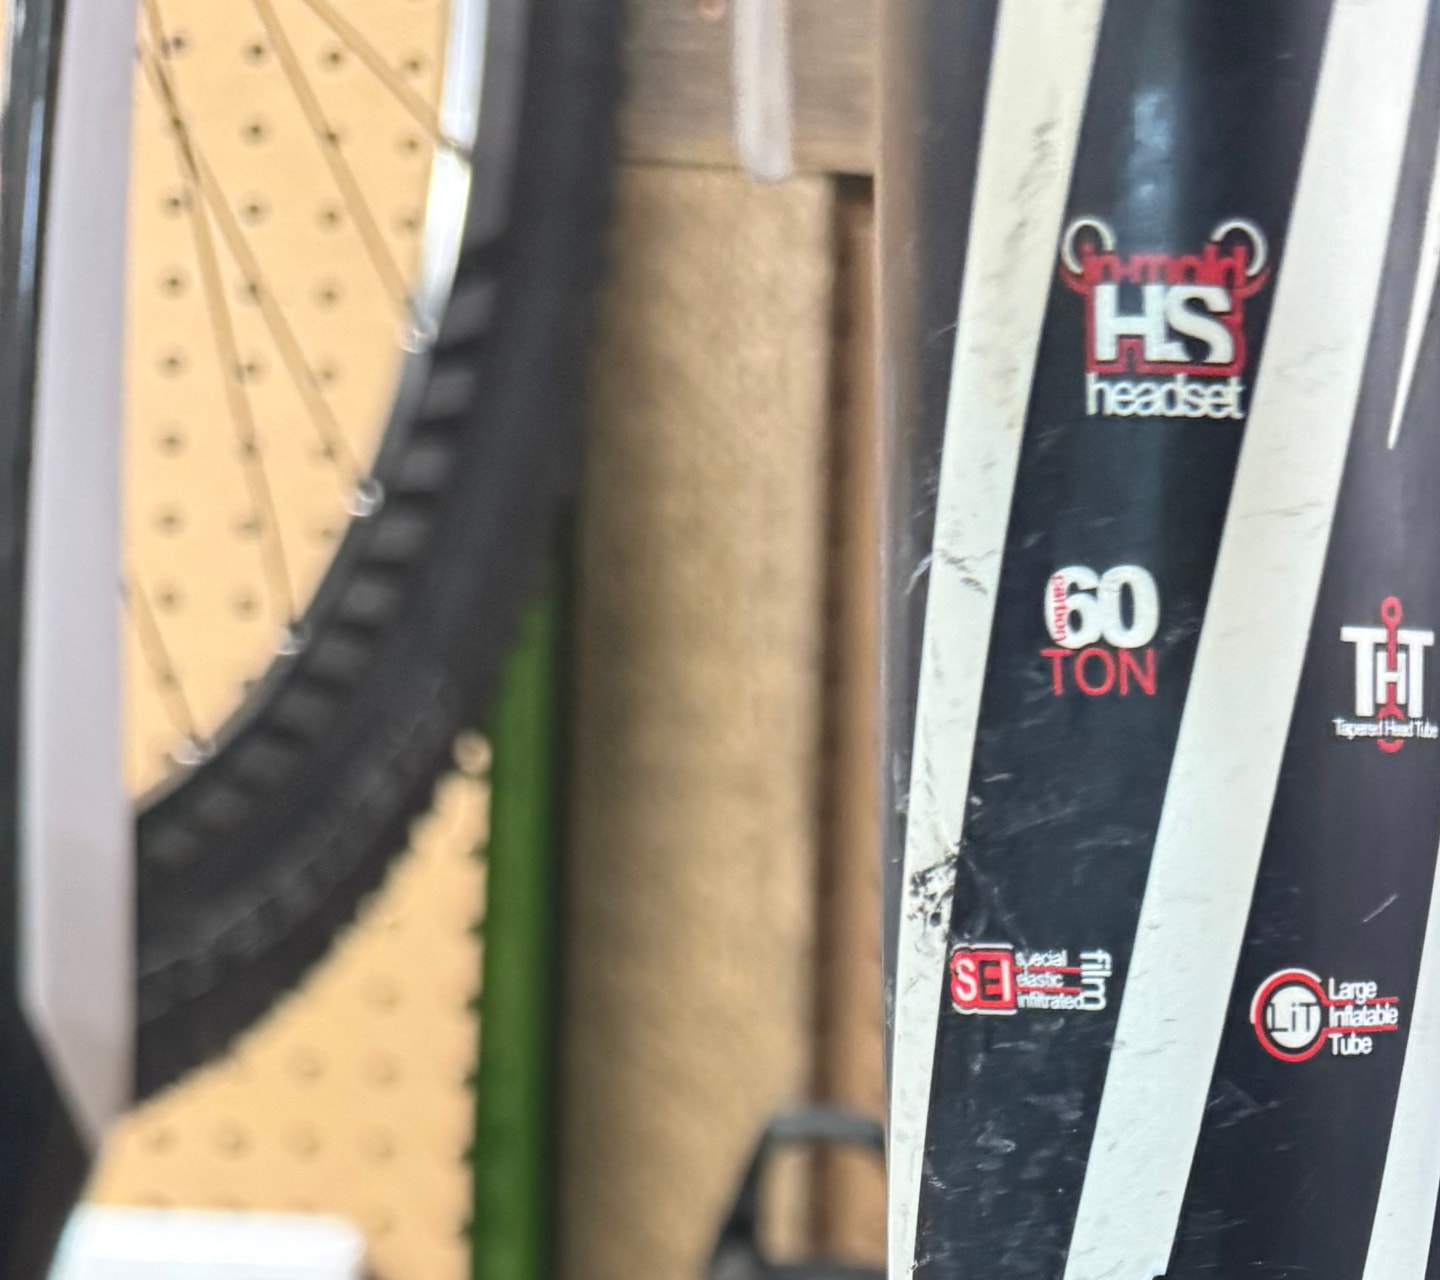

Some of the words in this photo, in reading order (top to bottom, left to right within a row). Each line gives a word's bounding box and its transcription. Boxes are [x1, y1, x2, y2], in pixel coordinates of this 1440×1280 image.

[1093, 283, 1235, 364] HS
[1086, 372, 1245, 420] headset
[1044, 564, 1160, 649] 60
[1040, 647, 1156, 696] TON
[1340, 625, 1435, 718] THT
[1332, 716, 1383, 740] Tapered
[1384, 718, 1414, 738] Head
[1414, 718, 1439, 739] Tube
[954, 958, 1012, 1002] SEI
[1328, 977, 1378, 1005] Large
[1328, 1002, 1399, 1029] Inflatable
[1327, 1031, 1374, 1056] Tube
